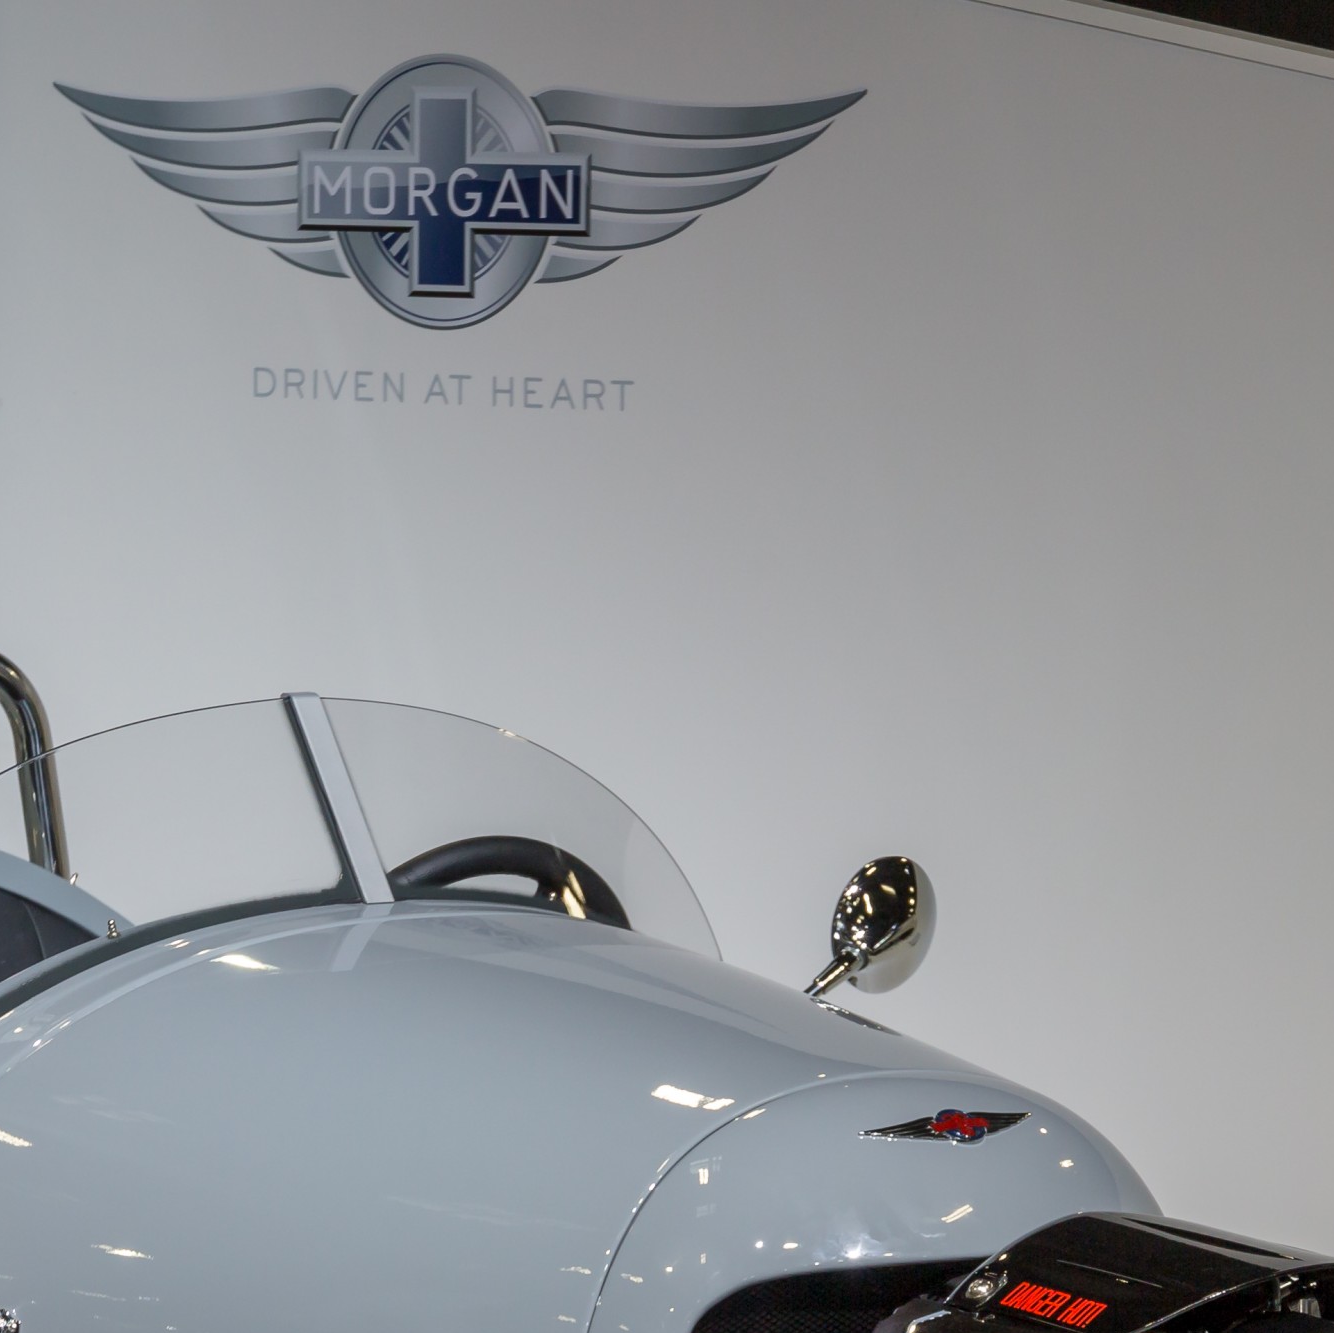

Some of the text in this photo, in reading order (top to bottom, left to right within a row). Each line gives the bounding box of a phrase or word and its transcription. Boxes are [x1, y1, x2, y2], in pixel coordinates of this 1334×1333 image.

[311, 165, 575, 221] MORGAN
[252, 367, 635, 413] DRIVEN AT HEART
[1000, 1281, 1108, 1329] DANGER HOT!
